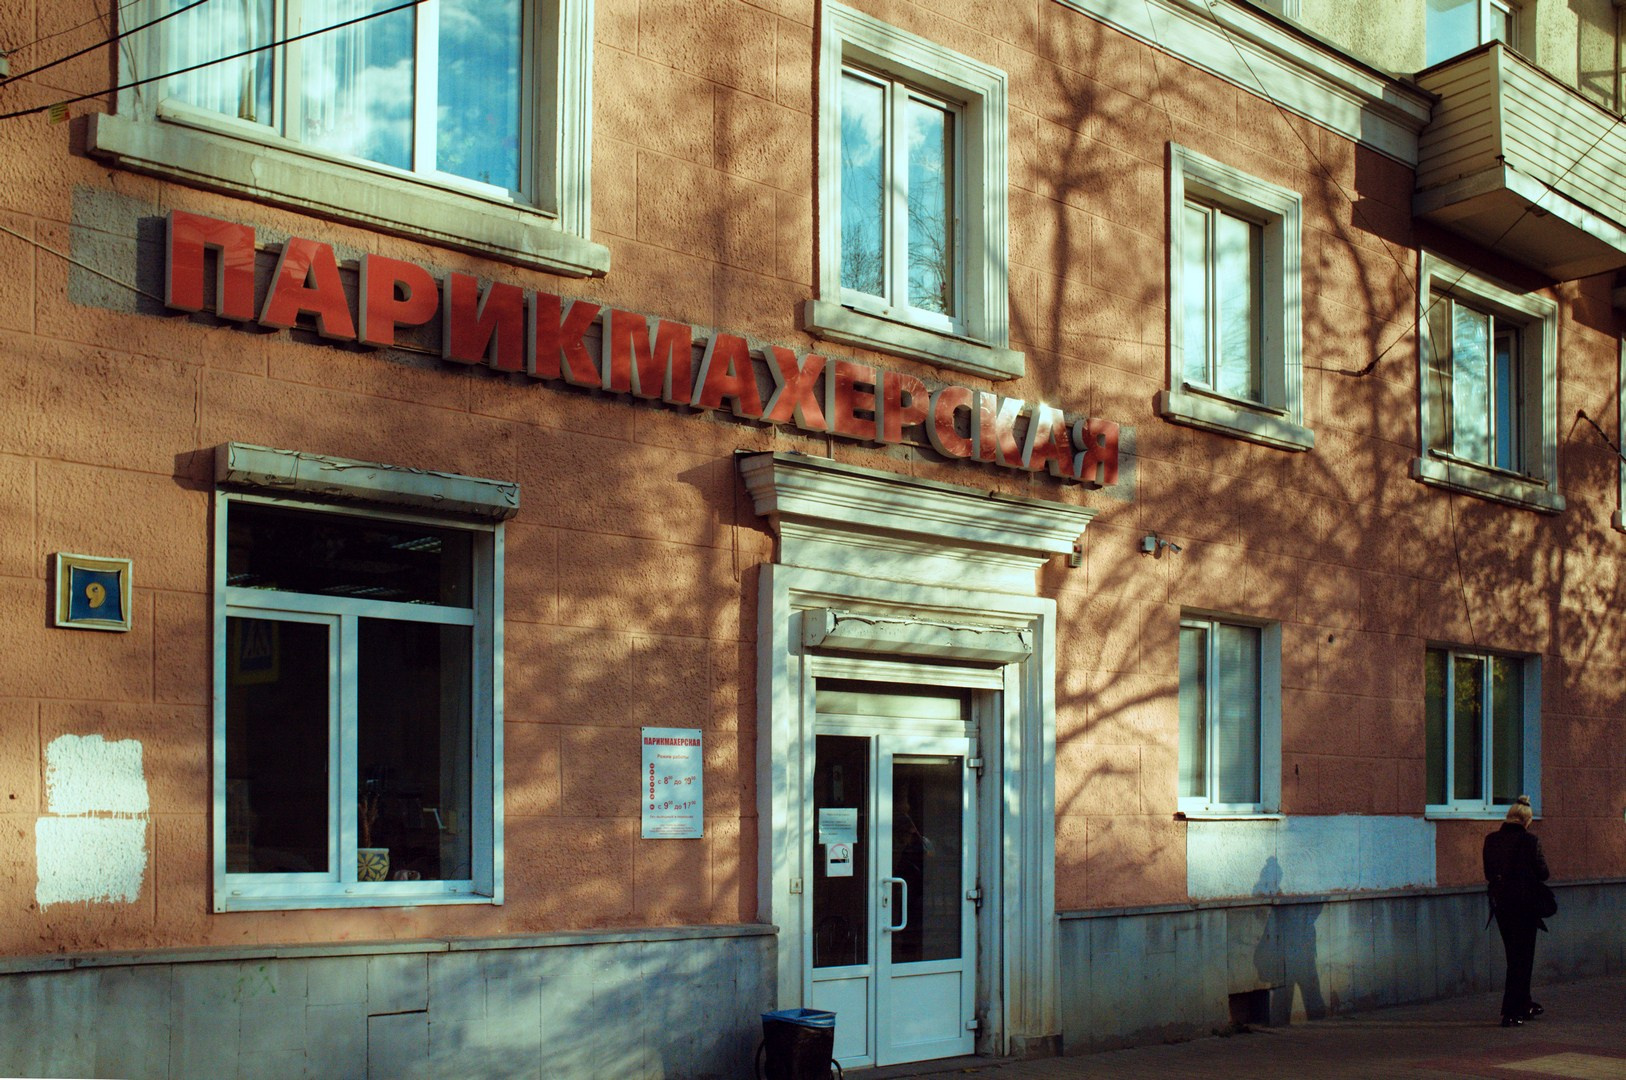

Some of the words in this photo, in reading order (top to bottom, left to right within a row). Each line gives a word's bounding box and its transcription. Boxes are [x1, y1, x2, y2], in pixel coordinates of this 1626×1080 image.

[165, 210, 1119, 486] ПАРИКМАХЕРСКАЯ
[85, 582, 106, 609] 9
[643, 737, 701, 747] ПАРИКМАХЕРСКАЯ
